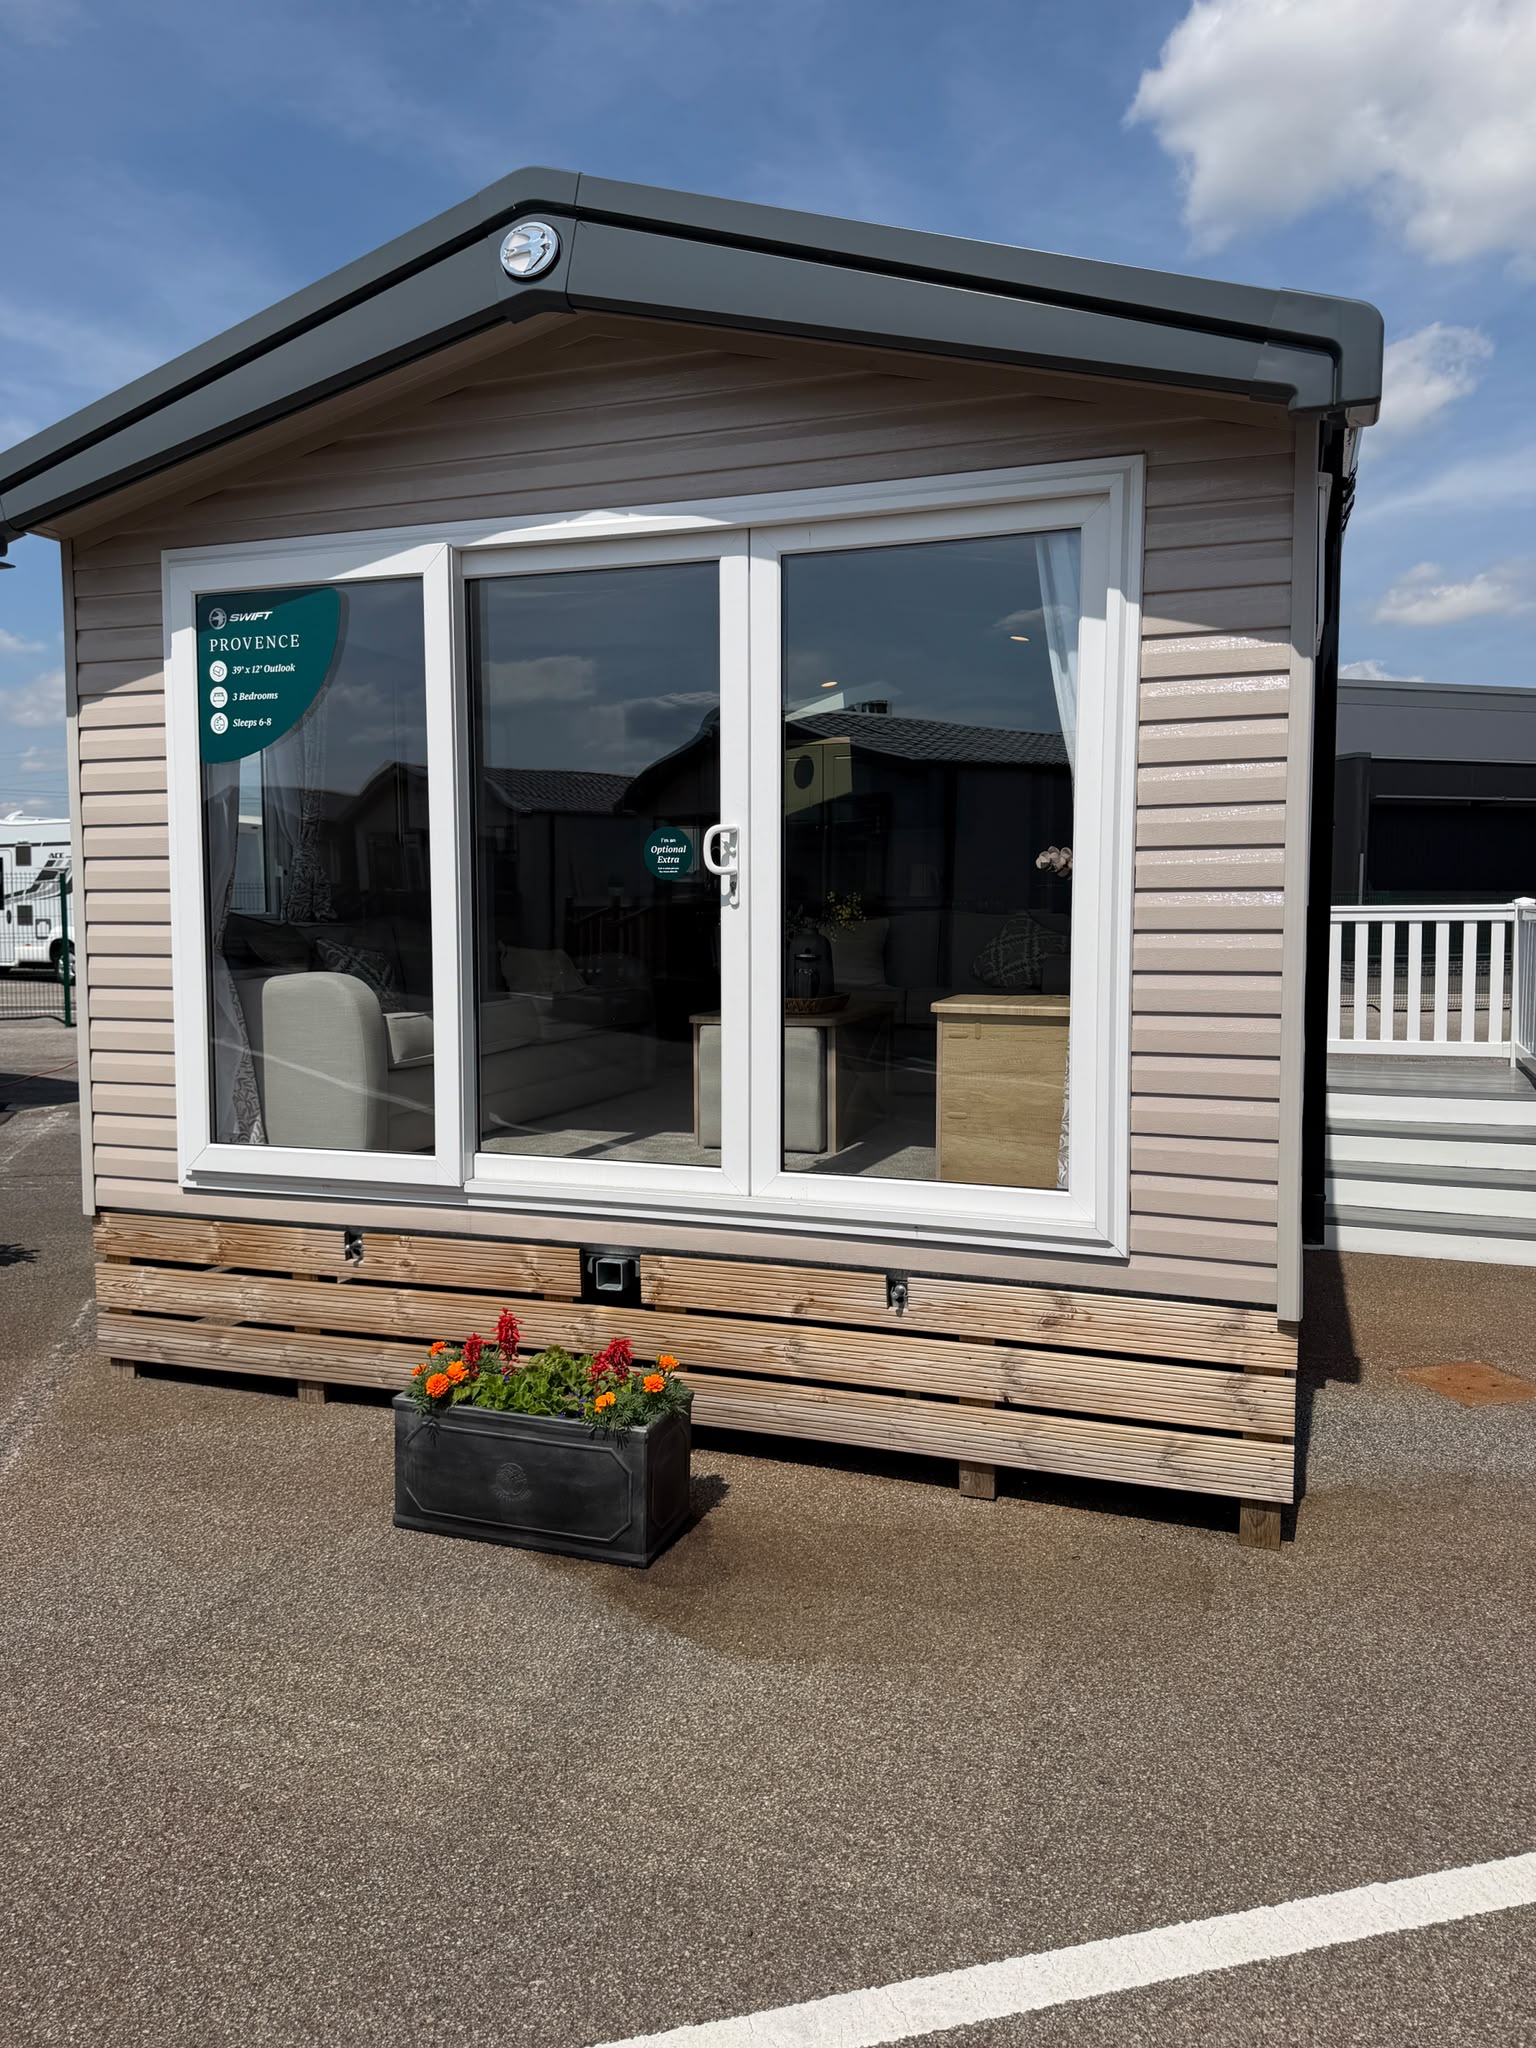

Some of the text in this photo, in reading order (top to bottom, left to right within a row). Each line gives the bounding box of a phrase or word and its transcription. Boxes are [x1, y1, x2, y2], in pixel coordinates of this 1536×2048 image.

[229, 611, 273, 622] SWIFT
[209, 634, 300, 652] PROVENCE
[244, 666, 251, 674] x
[263, 663, 296, 673] Outlook
[232, 691, 279, 701] 3 Bedrooms
[232, 717, 272, 729] Sleeps 6-8
[650, 845, 687, 855] Optional
[657, 855, 680, 864] Extra
